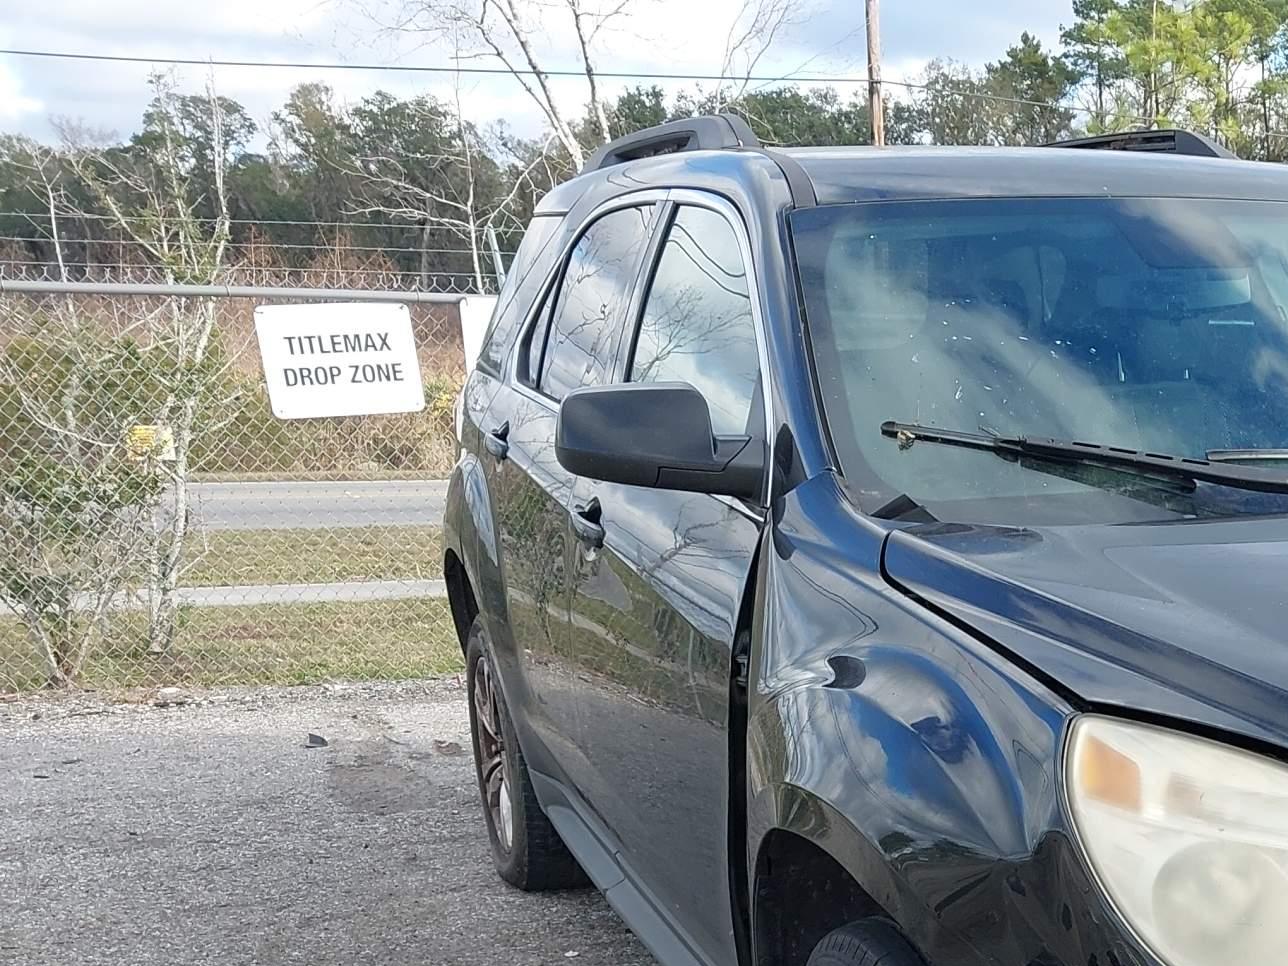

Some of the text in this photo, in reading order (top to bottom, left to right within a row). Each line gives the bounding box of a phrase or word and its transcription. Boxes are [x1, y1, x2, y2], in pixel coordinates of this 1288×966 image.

[283, 332, 392, 355] TITLEMAX
[283, 362, 404, 387] DROP ZONE
